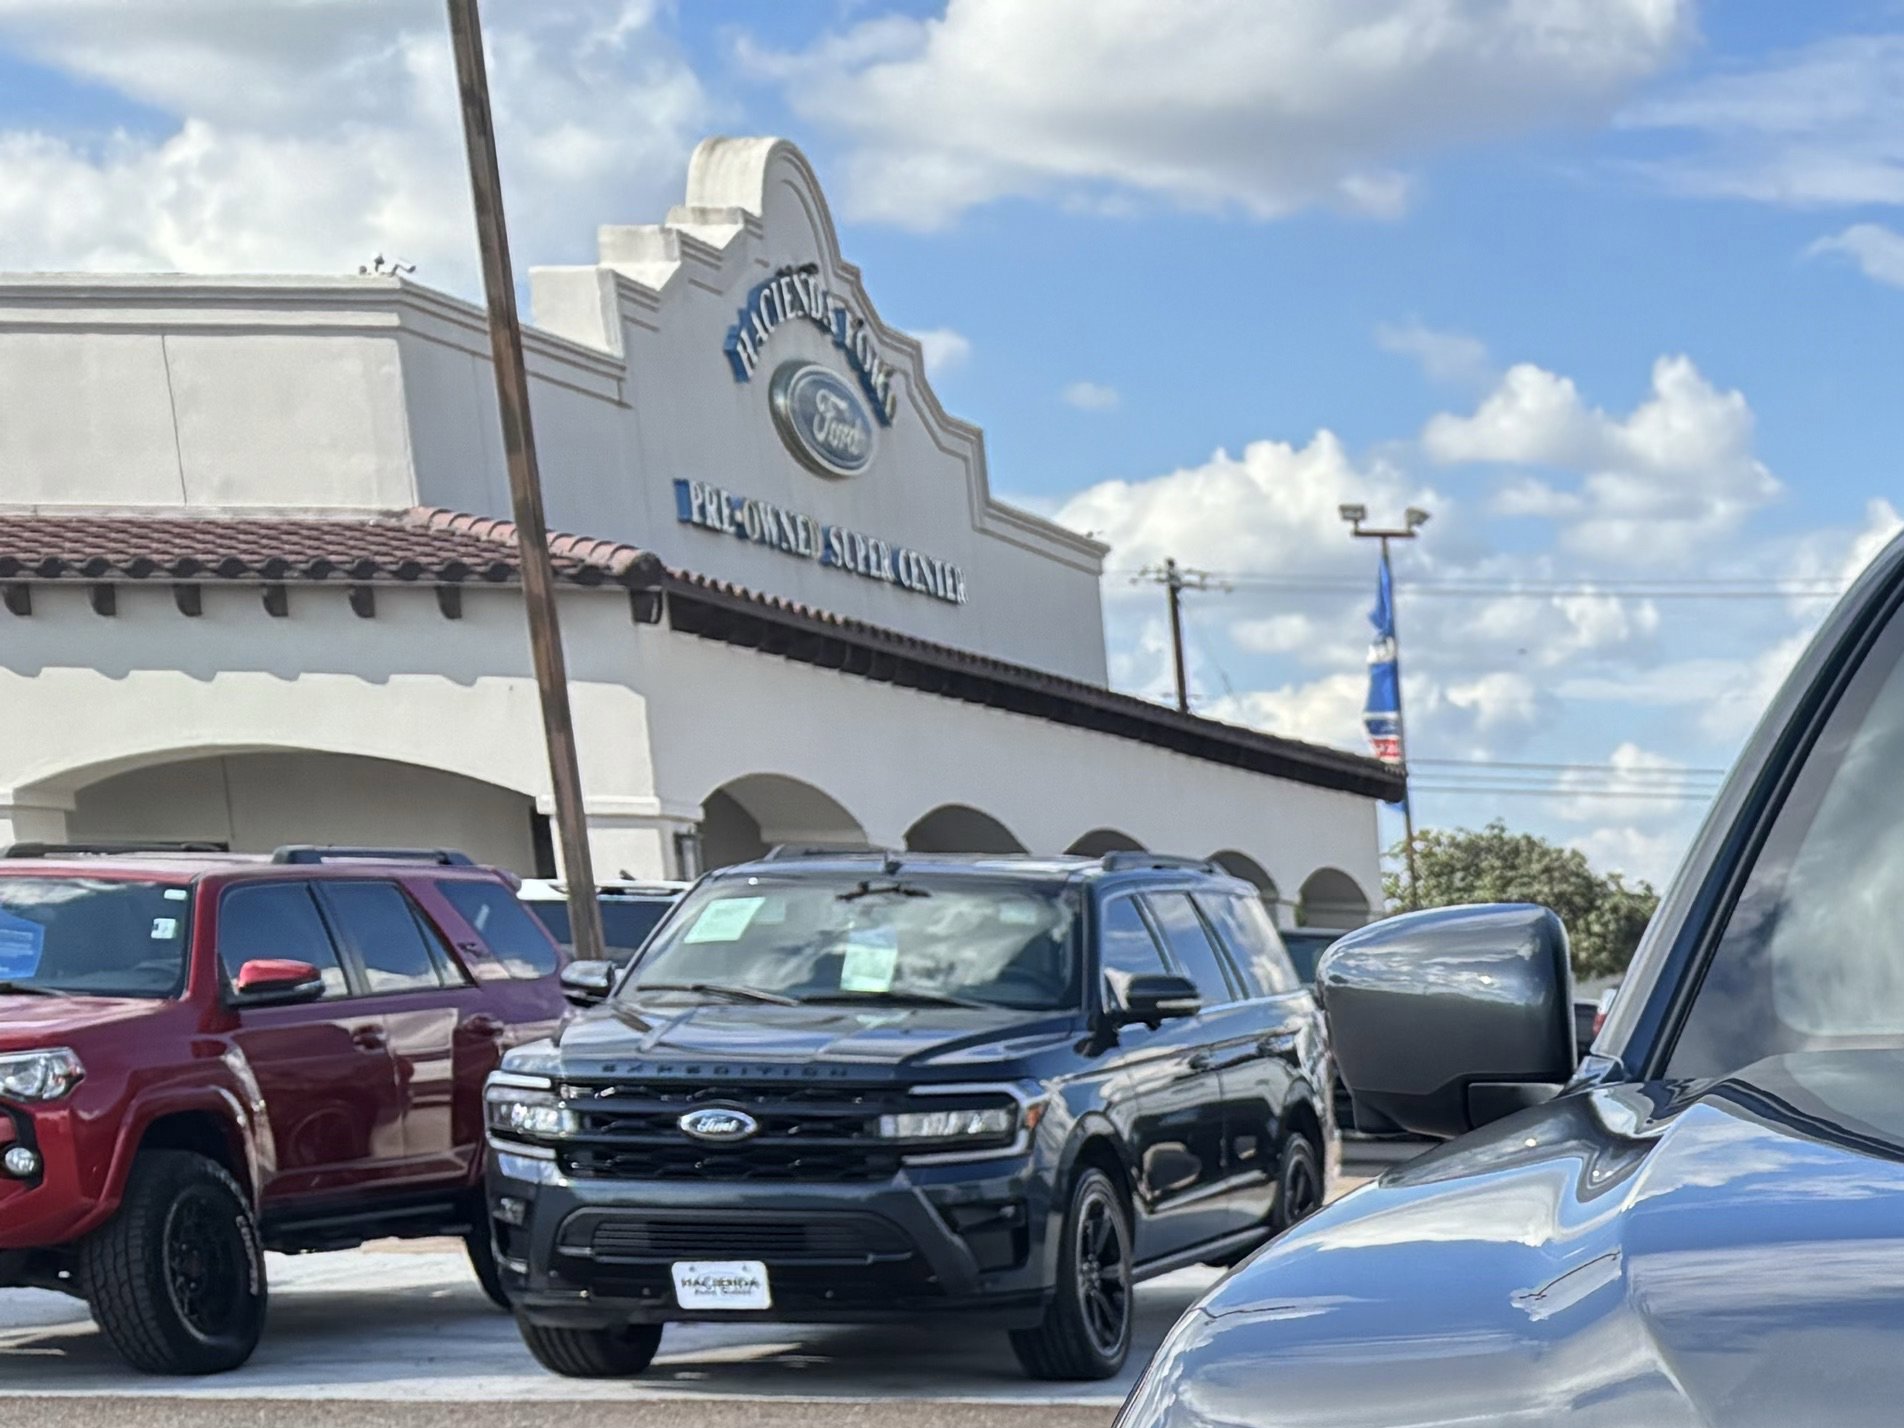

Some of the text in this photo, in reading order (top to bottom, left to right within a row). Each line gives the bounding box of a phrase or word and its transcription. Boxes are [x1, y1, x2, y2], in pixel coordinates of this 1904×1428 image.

[730, 270, 839, 380] HACIENDA
[813, 388, 868, 454] Ford
[689, 480, 968, 604] PRE-OWNED SUPER CENTER
